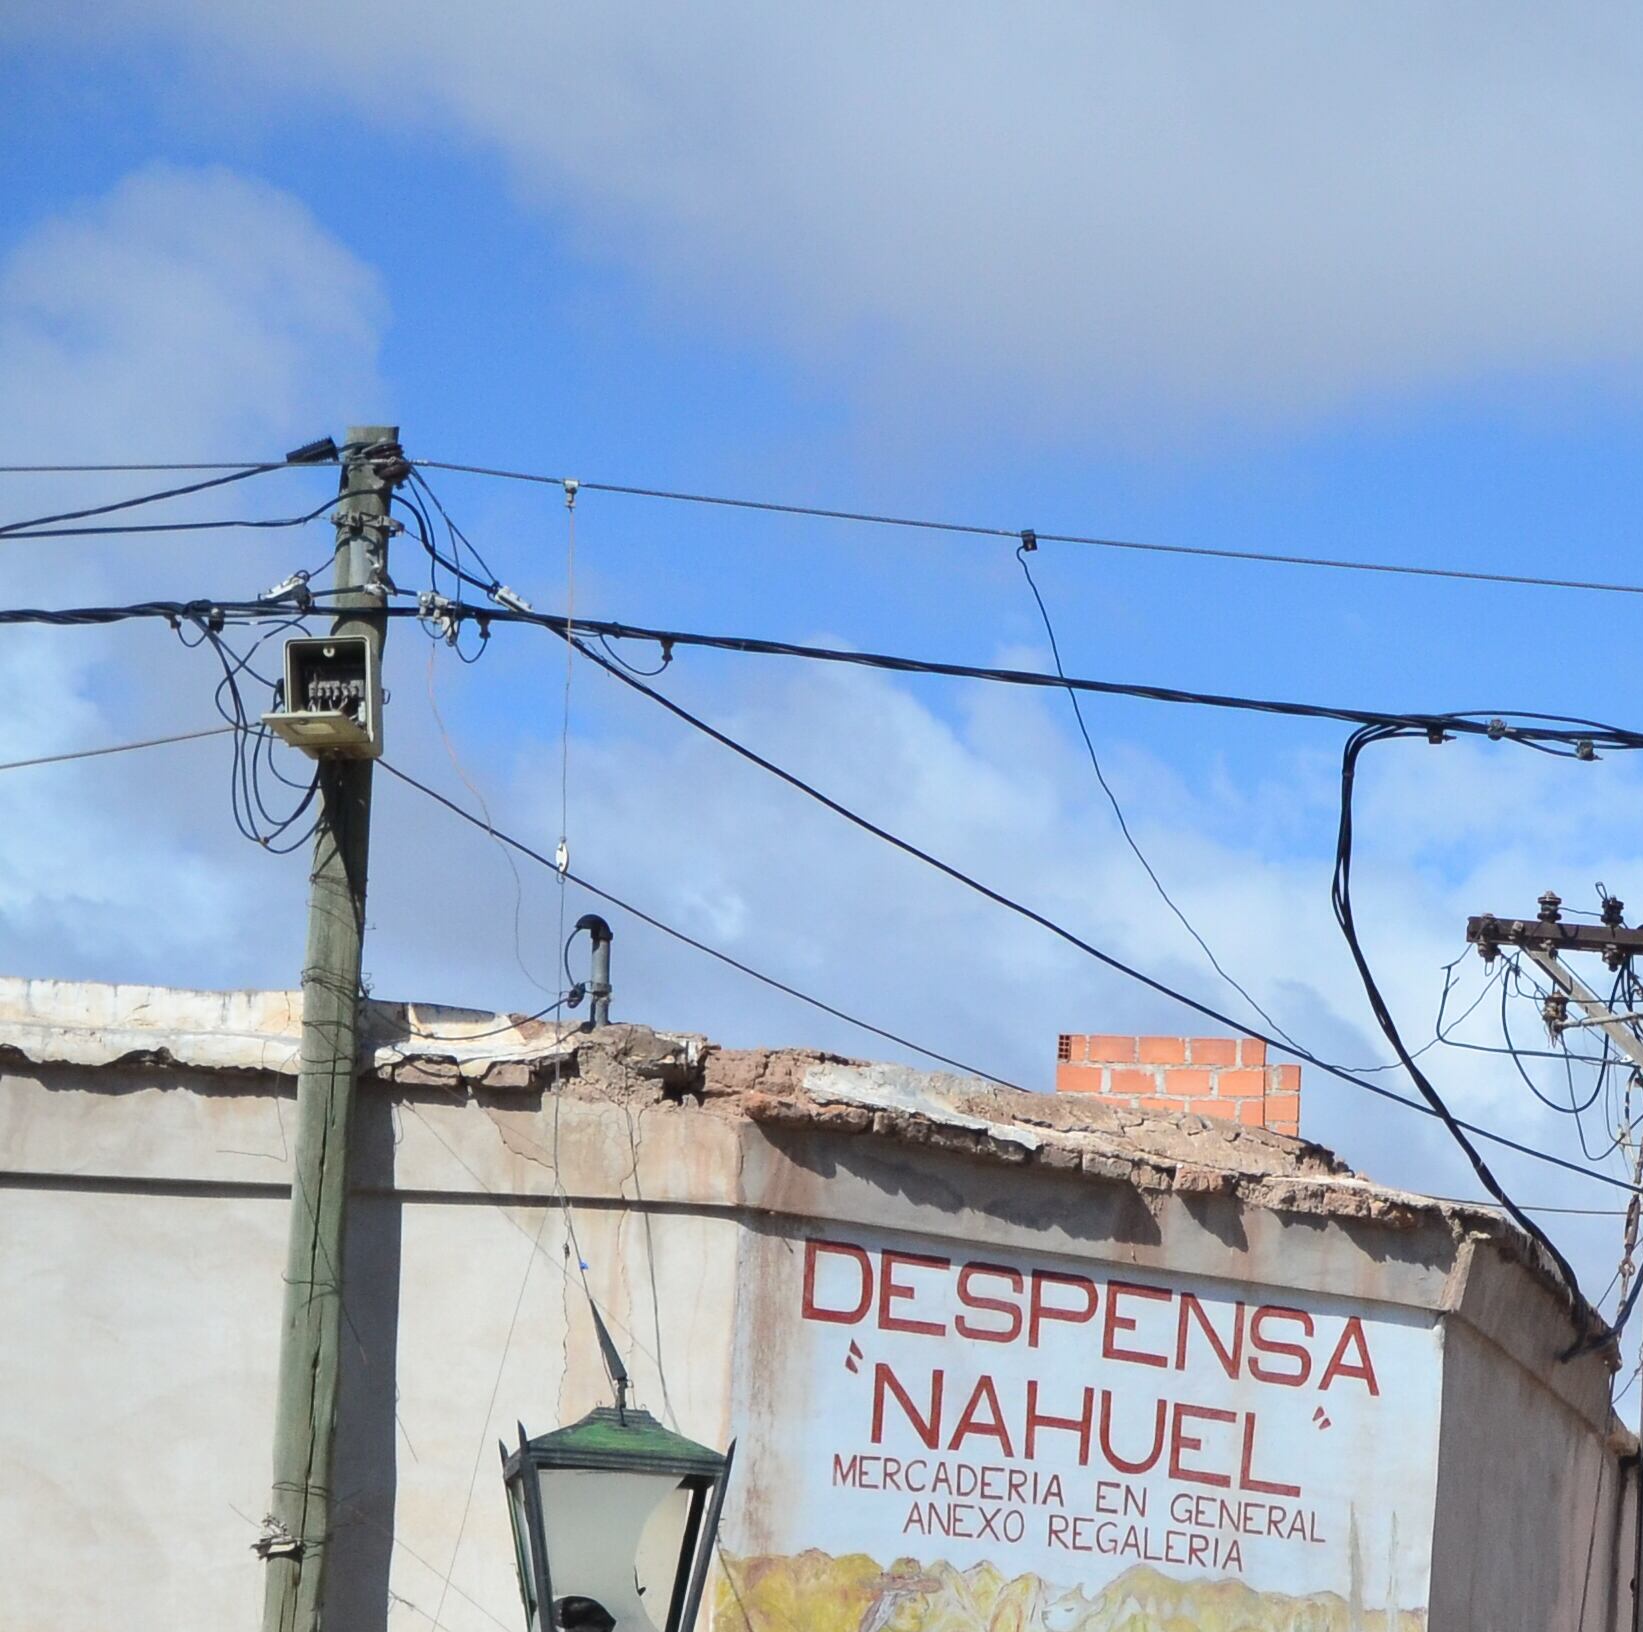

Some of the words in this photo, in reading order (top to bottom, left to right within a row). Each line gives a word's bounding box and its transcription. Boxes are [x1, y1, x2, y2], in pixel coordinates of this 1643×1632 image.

[802, 1238, 1378, 1396] DESPENSA
[833, 1454, 1064, 1506] MERCADERIA
[1096, 1481, 1147, 1517] EN
[1171, 1493, 1326, 1543] GENERAL
[903, 1502, 1025, 1543] ANEXO
[1047, 1515, 1243, 1572] REGALERIA
